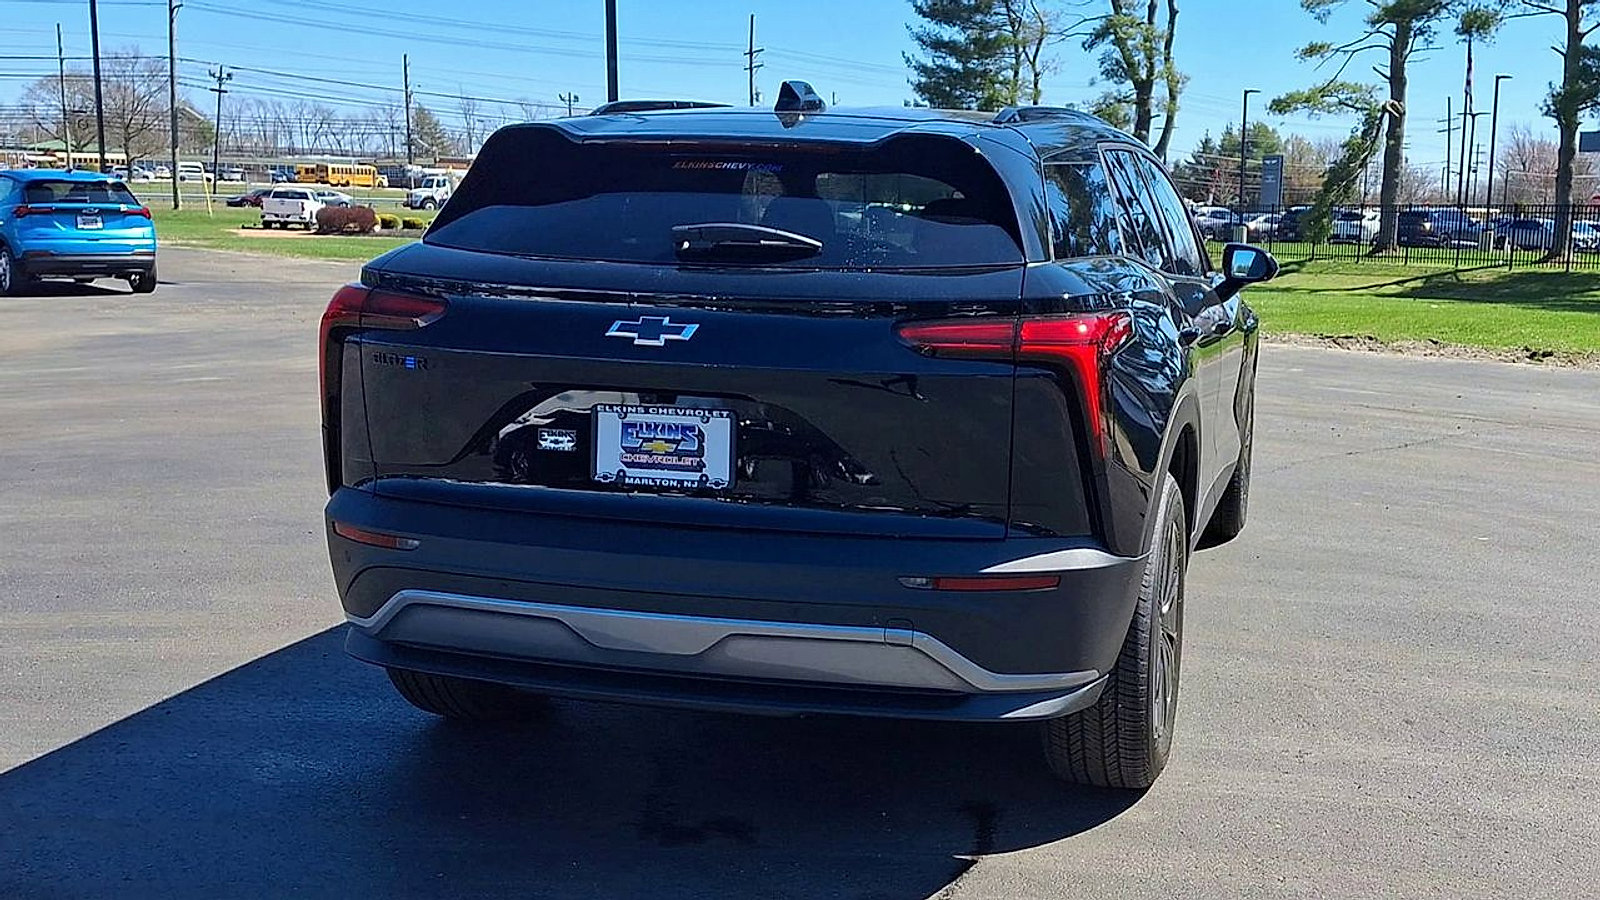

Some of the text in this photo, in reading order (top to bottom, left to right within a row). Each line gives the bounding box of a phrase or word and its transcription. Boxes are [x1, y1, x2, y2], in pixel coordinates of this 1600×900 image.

[596, 405, 730, 418] ELKINS CHEVROLET
[621, 421, 699, 451] ELKINS
[620, 453, 702, 466] CHEVROLET
[624, 477, 699, 488] MARLTON, NJ
